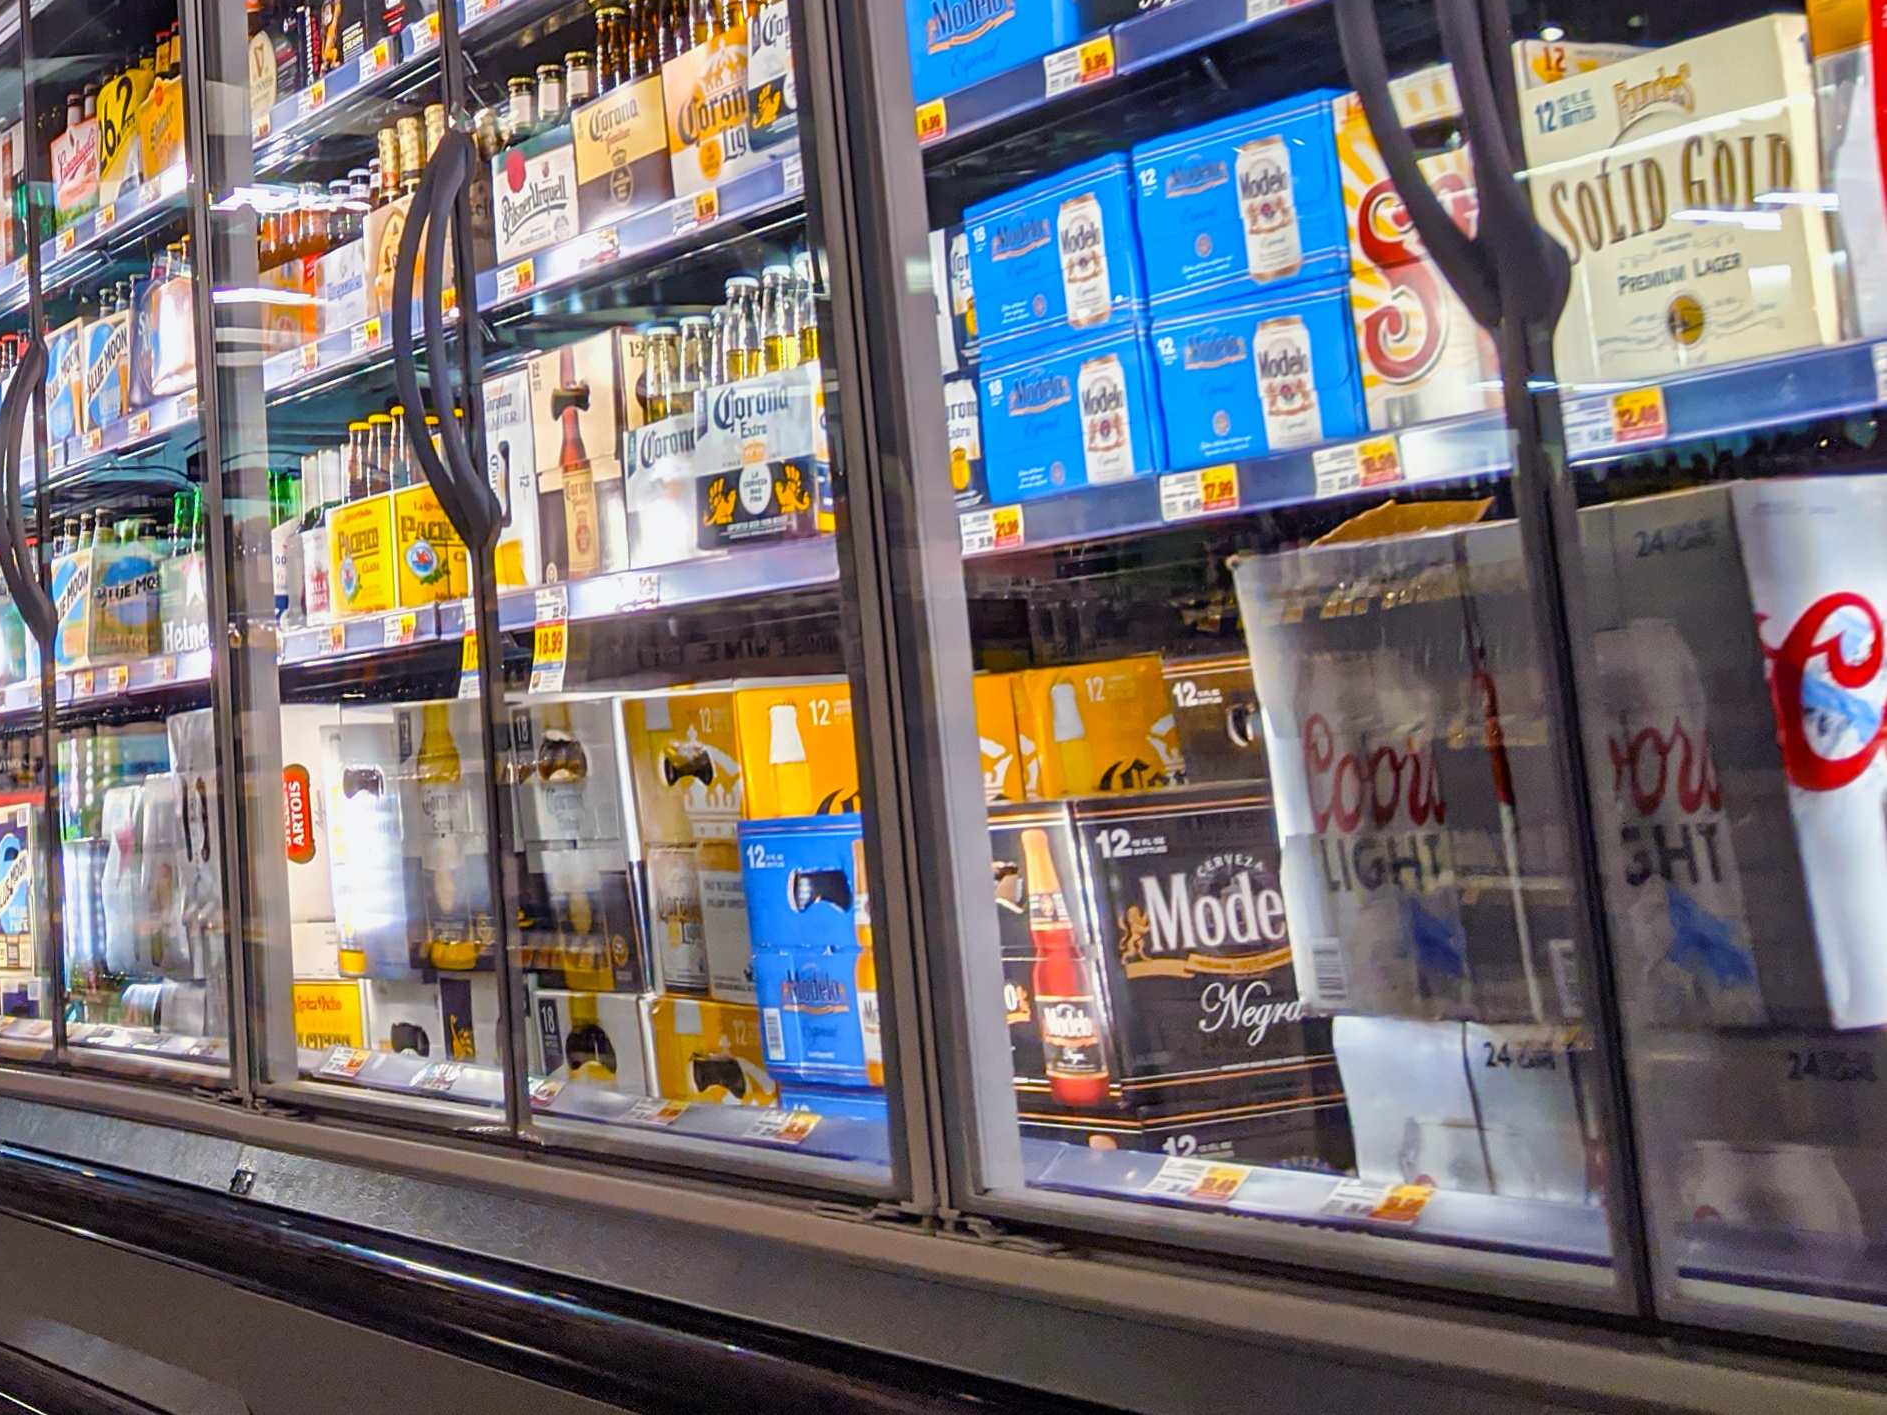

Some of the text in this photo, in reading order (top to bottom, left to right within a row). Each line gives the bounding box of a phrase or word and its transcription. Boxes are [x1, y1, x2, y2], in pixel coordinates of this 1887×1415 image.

[1543, 45, 1567, 74] 12
[589, 97, 640, 143] Corona
[1535, 101, 1558, 134] 12
[1138, 167, 1157, 187] 12
[1550, 133, 1793, 266] SOLID GOLD
[972, 225, 986, 244] 18
[1618, 252, 1741, 296] PREMIUM LAGER
[629, 341, 645, 359] 12
[1157, 336, 1177, 357] 12
[987, 378, 1003, 397] 18
[713, 384, 789, 437] Corona
[740, 420, 768, 442] Extra
[1202, 480, 1234, 500] 17.99
[163, 618, 210, 653] Heine
[537, 630, 563, 657] 18.99
[1085, 676, 1105, 702] 12
[1172, 680, 1197, 708] 12
[811, 699, 830, 725] 12
[517, 717, 529, 741] 18
[290, 778, 305, 849] ARTOIS
[1096, 827, 1131, 859] 12
[745, 845, 765, 870] 12
[1195, 852, 1265, 878] CERVEZA
[1139, 870, 1286, 954] Mode
[540, 1013, 556, 1033] 18
[1197, 980, 1305, 1047] Negra
[1483, 1041, 1513, 1070] 24
